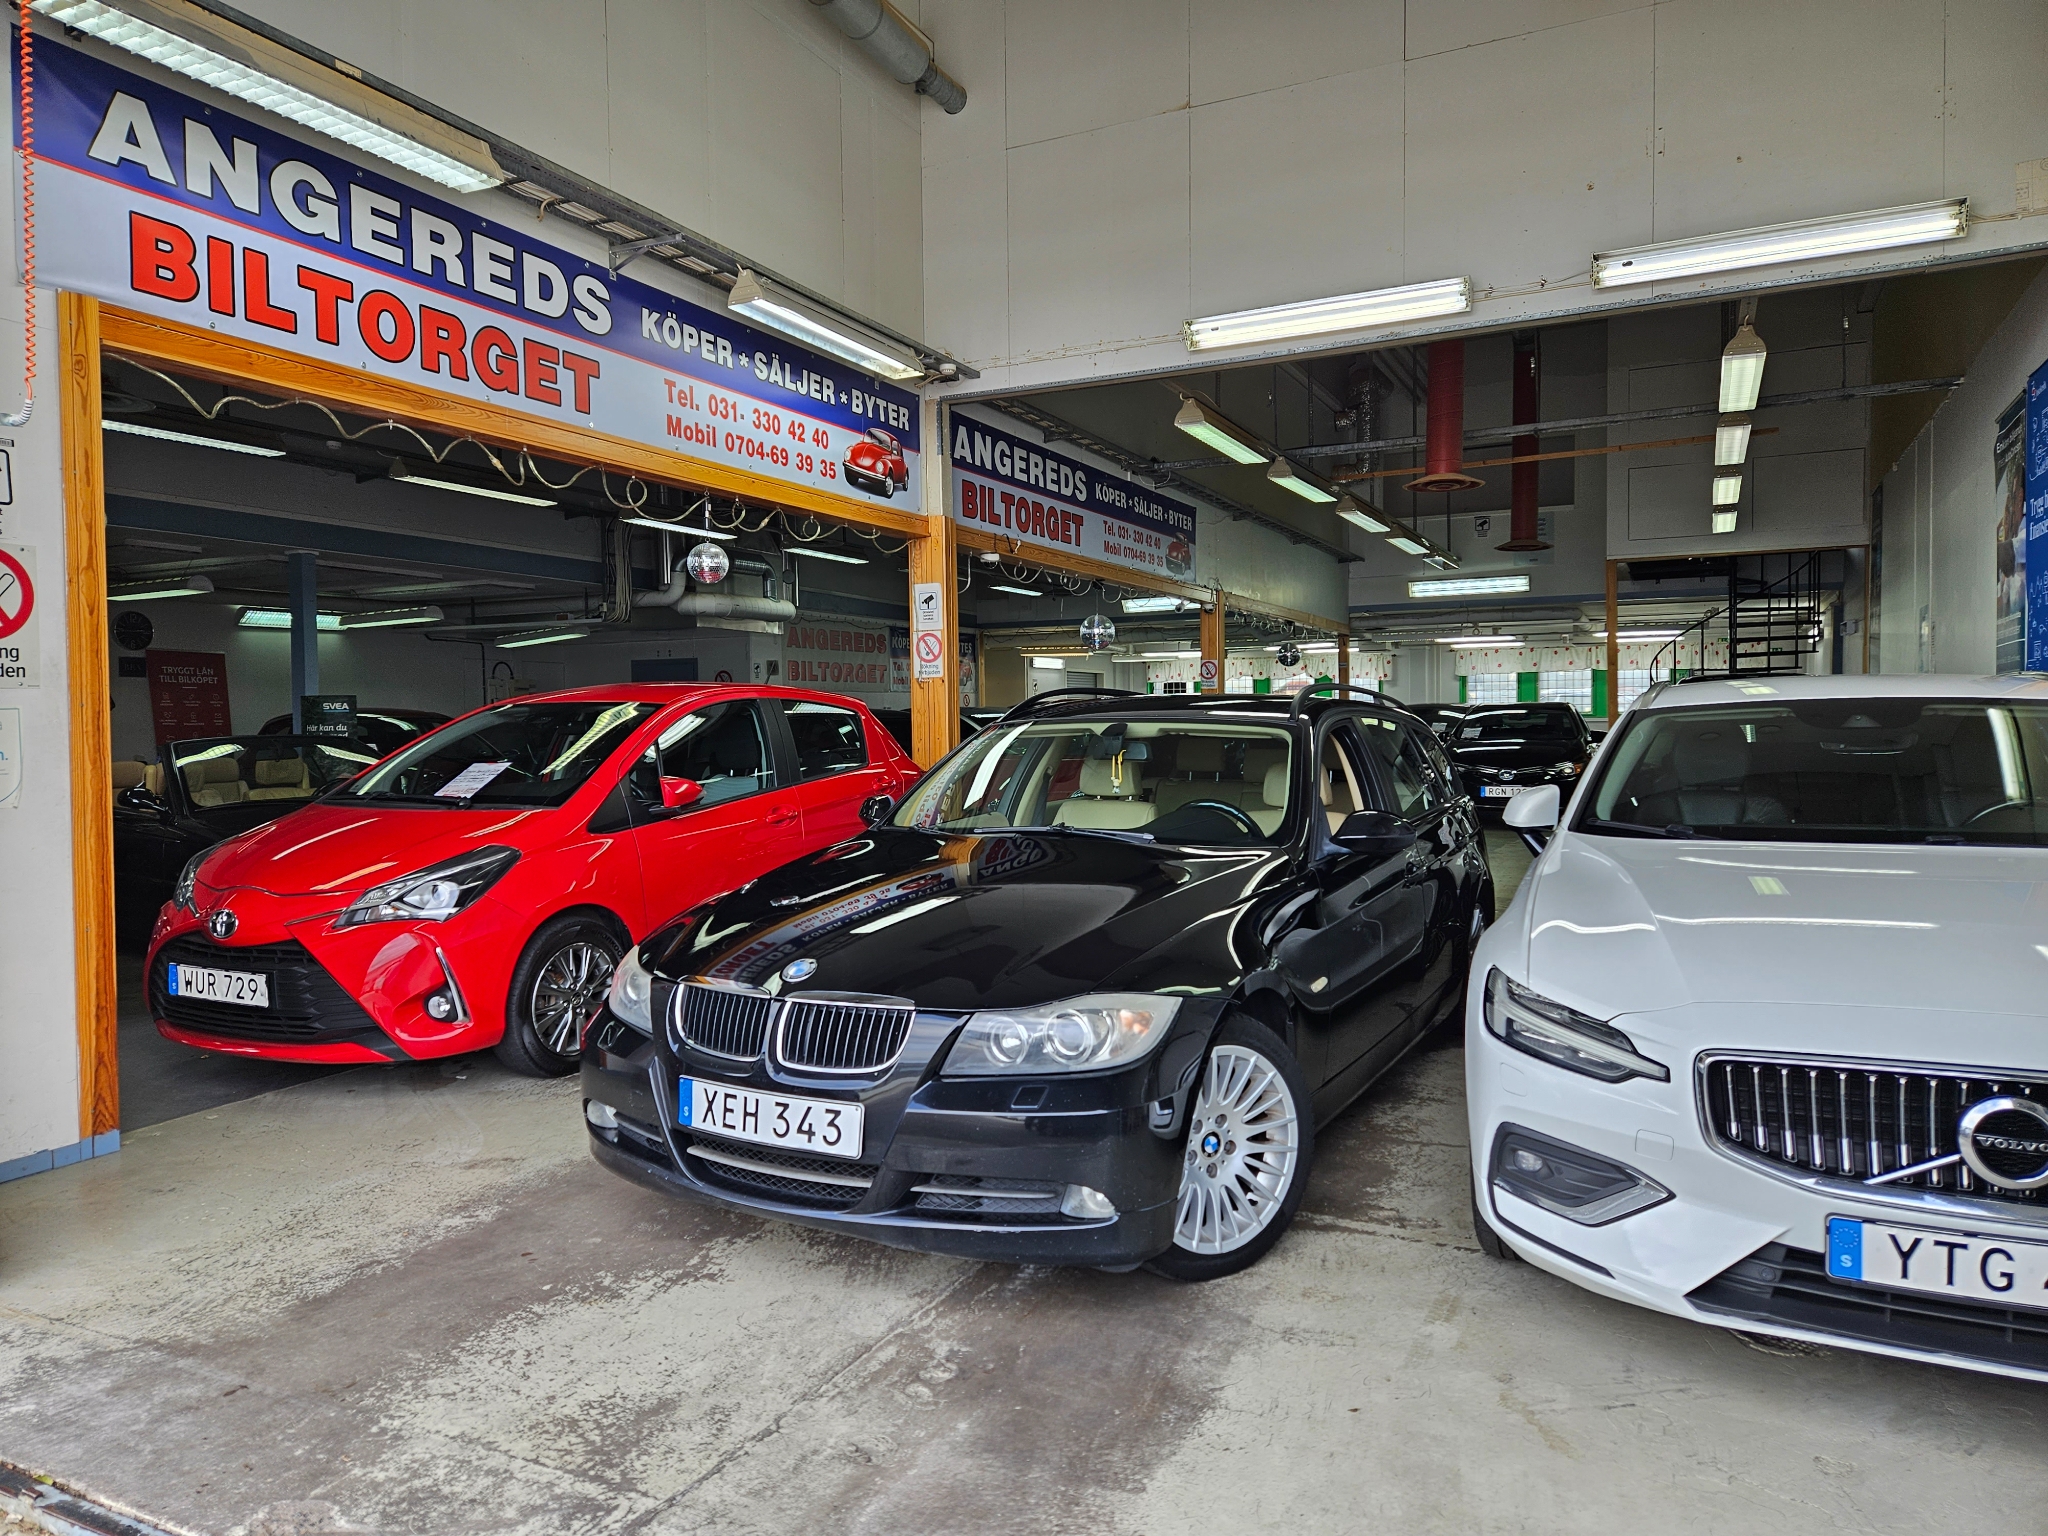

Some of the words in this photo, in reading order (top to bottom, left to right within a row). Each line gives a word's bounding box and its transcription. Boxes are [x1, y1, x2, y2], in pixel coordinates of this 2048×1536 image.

[87, 90, 612, 335] ANGEREDS
[129, 210, 600, 414] BILTORGET
[641, 306, 734, 369] KÖPER
[754, 351, 836, 406] SÄLJER
[852, 388, 910, 431] BYTER
[664, 378, 700, 411] Tel.
[708, 394, 745, 423] 031-
[752, 408, 780, 435] 330
[788, 420, 806, 443] 42
[812, 428, 829, 450] 40
[667, 414, 717, 448] Mobil
[725, 432, 789, 467] 0704-69
[795, 452, 813, 473] 39
[820, 459, 837, 480] 35
[954, 425, 1087, 502] ANGEREDS
[962, 479, 1084, 547] BILTORGET
[1095, 482, 1127, 509] KÖPER
[1134, 496, 1163, 521] SÄLJER
[1168, 509, 1192, 532] BYTER
[1103, 520, 1115, 537] Tel.
[1104, 541, 1121, 556] Mobil
[786, 626, 887, 655] ANGEREDS
[892, 635, 910, 648] KÖPE
[159, 675, 177, 683] TILL
[179, 675, 218, 685] BILKÖPET
[161, 666, 195, 675] TRYGGT
[196, 666, 214, 675] LÅN
[787, 660, 887, 683] BILTORGET
[322, 702, 349, 710] SVEA
[319, 723, 334, 731] kan
[336, 723, 347, 731] du
[1488, 787, 1507, 796] RGN
[1510, 787, 1527, 796] 12
[184, 969, 217, 996] WUR
[224, 974, 258, 1001] 729
[702, 1088, 760, 1135] XEH
[773, 1101, 842, 1147] 343
[1976, 1136, 2048, 1152] VOLVO
[1840, 1254, 1853, 1267] S
[1887, 1233, 2015, 1293] YTG
